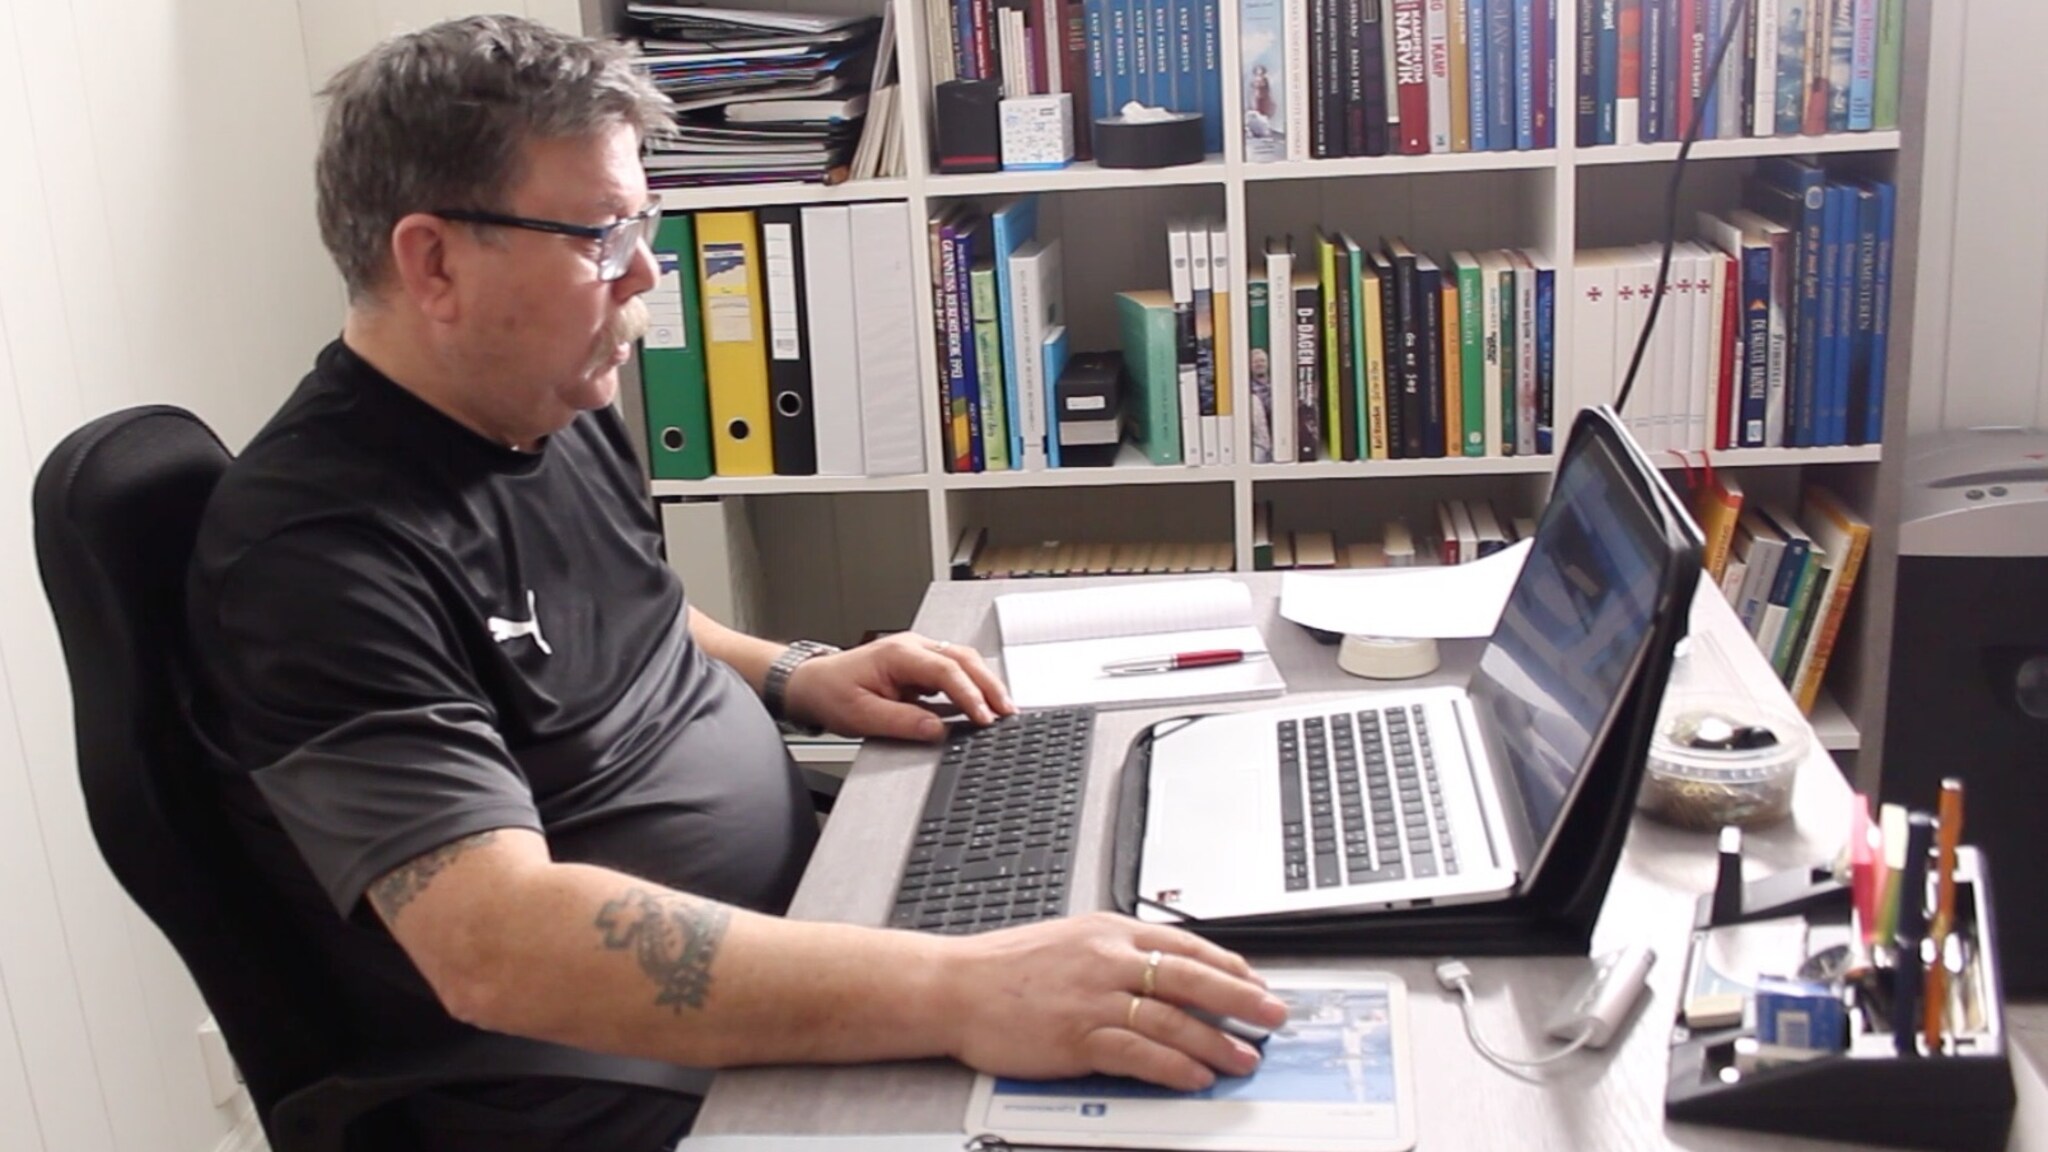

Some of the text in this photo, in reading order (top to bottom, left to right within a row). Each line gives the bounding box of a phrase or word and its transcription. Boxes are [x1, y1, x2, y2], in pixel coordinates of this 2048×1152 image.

[1396, 11, 1412, 85] NARVIK
[1411, 10, 1422, 62] KAMPEN
[1432, 44, 1446, 78] KAMP
[942, 240, 957, 291] GUINNESS
[1297, 308, 1314, 365] D-DAGEN
